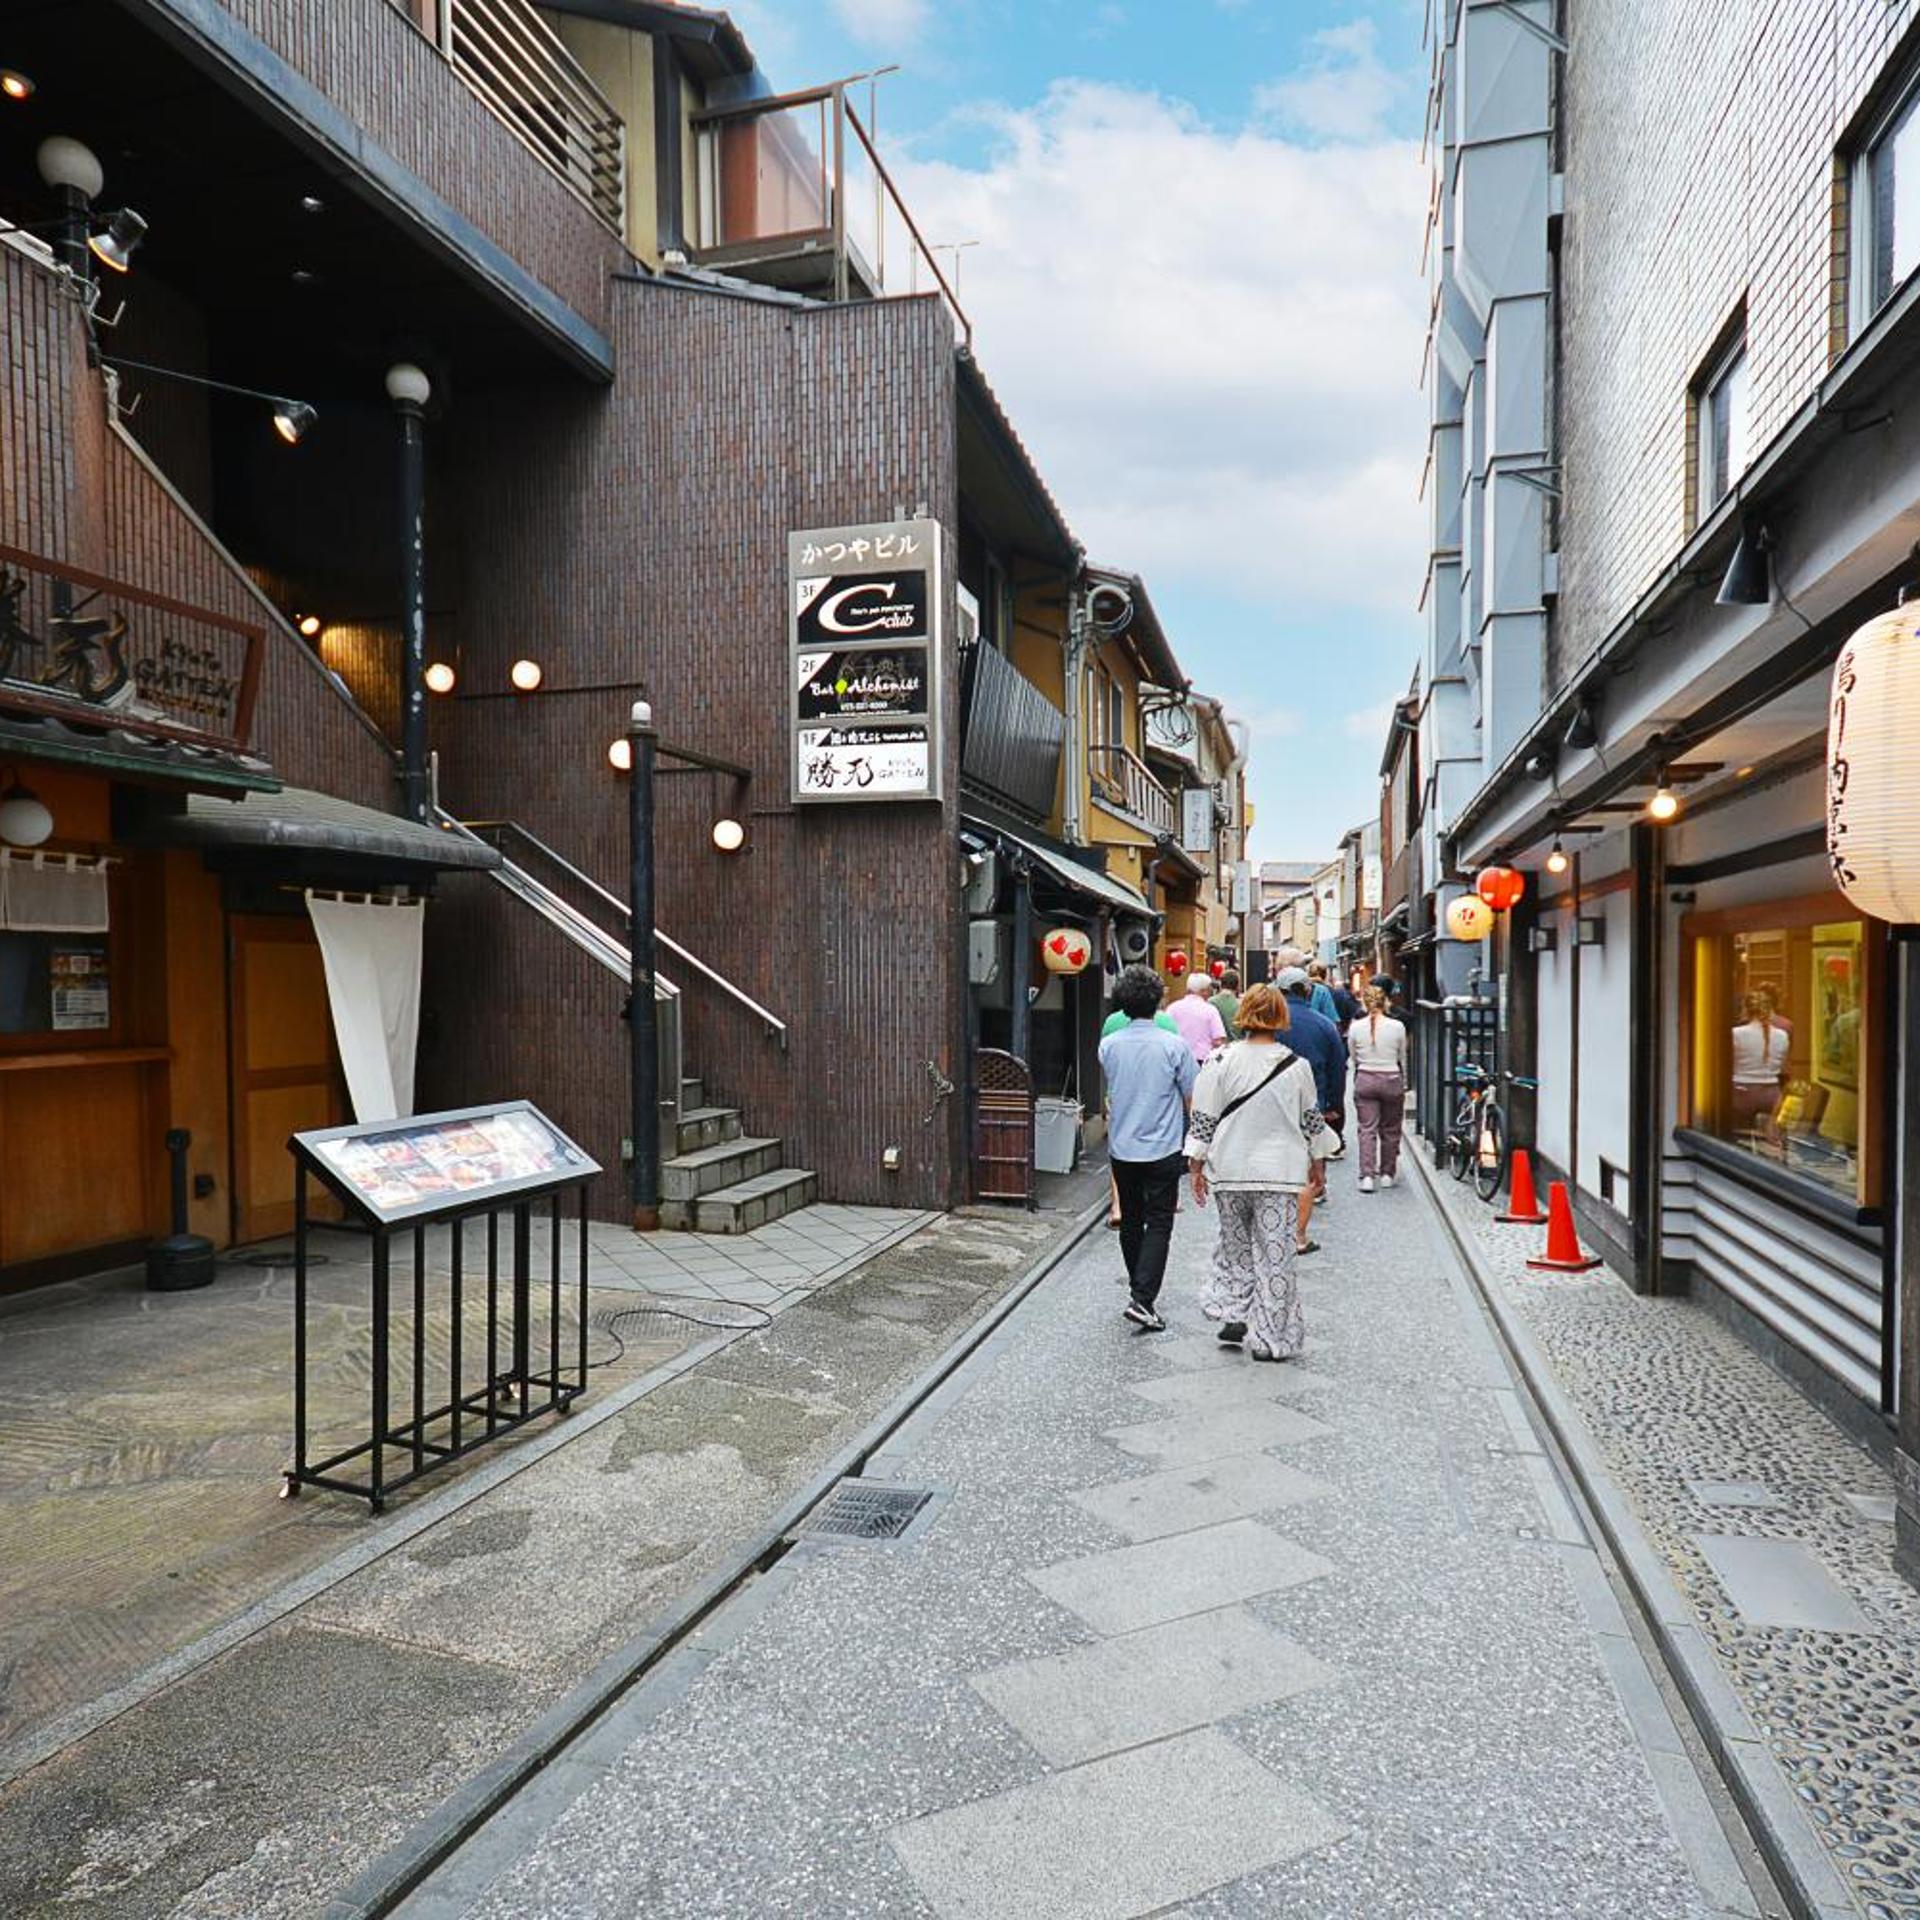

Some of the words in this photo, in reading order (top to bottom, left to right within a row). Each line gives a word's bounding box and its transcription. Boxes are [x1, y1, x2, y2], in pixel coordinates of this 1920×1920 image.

[801, 533, 920, 565] かつやビル
[801, 585, 816, 598] 3F
[801, 660, 816, 673] 2F
[803, 733, 817, 745] 1F
